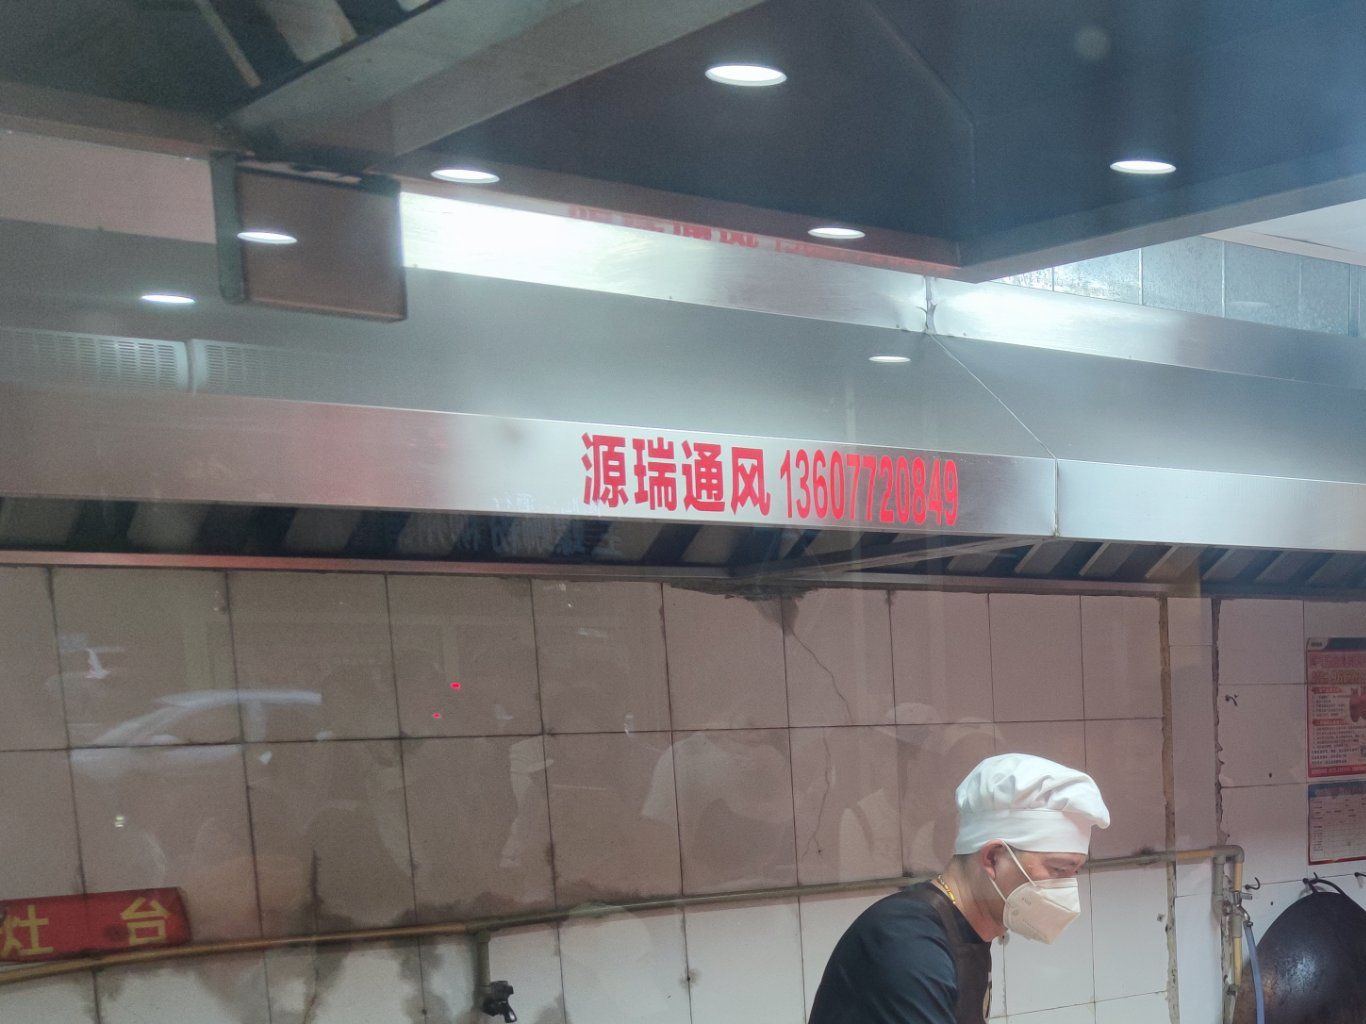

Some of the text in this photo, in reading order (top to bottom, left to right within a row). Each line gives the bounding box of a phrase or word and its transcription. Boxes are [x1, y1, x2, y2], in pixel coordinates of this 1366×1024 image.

[581, 433, 959, 527] 源瑞通风 13607720849
[0, 896, 172, 957] 灶台
